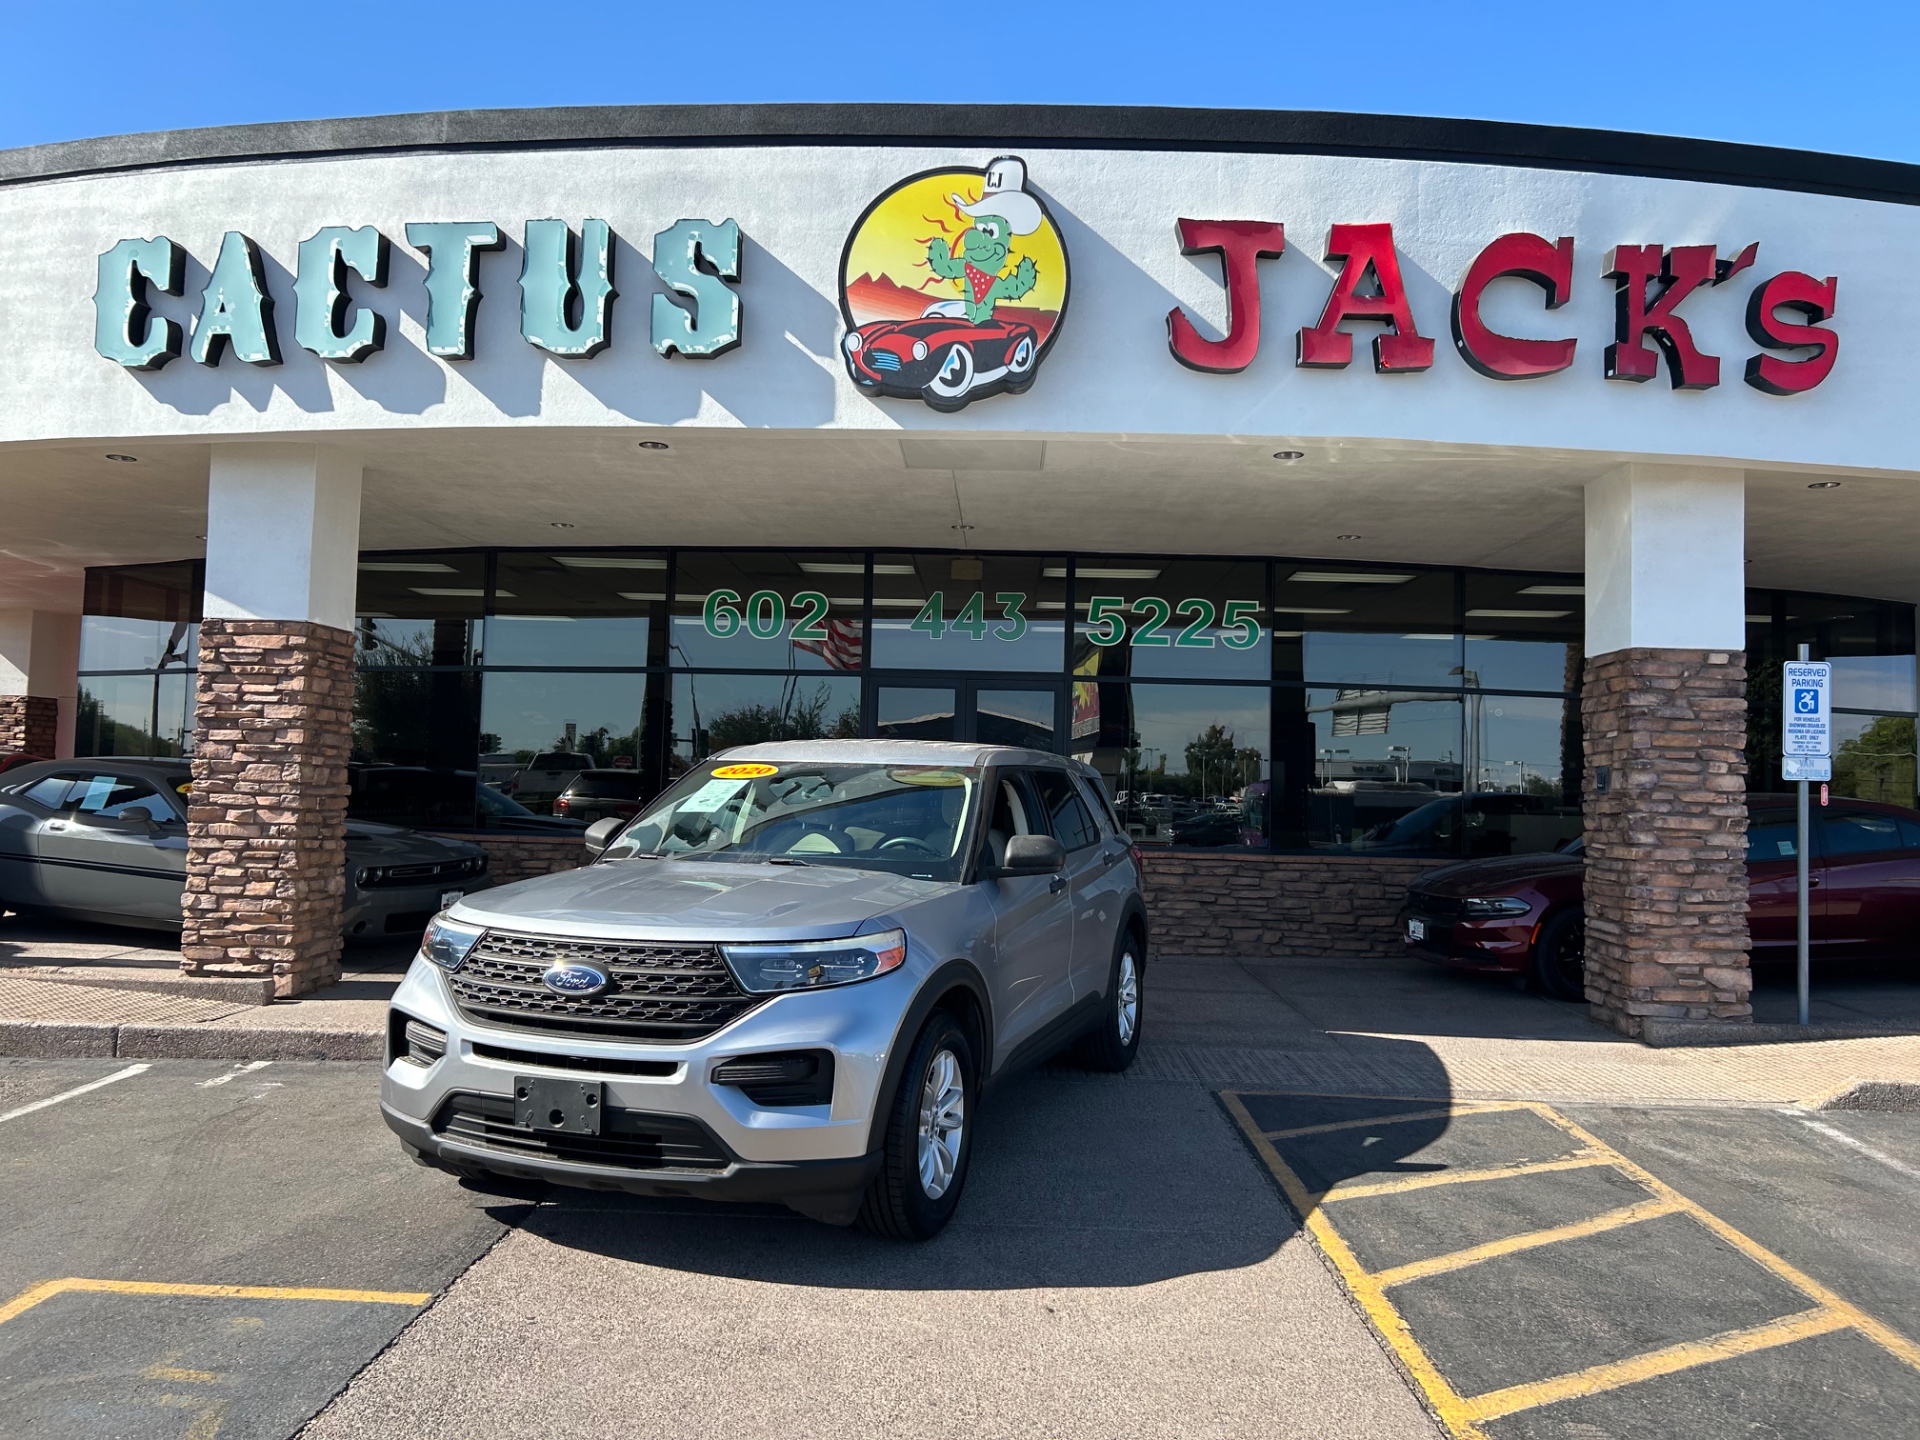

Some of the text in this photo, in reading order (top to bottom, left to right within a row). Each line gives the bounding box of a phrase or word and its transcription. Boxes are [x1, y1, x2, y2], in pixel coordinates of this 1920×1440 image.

[987, 171, 1003, 188] CJ
[92, 217, 745, 371] CACTUS
[702, 589, 1261, 651] 602 443 5225
[1788, 667, 1827, 677] RESERVED
[1792, 679, 1824, 688] PARKING
[1799, 759, 1815, 768] VAN
[719, 767, 772, 775] 2020
[556, 970, 590, 988] Ford
